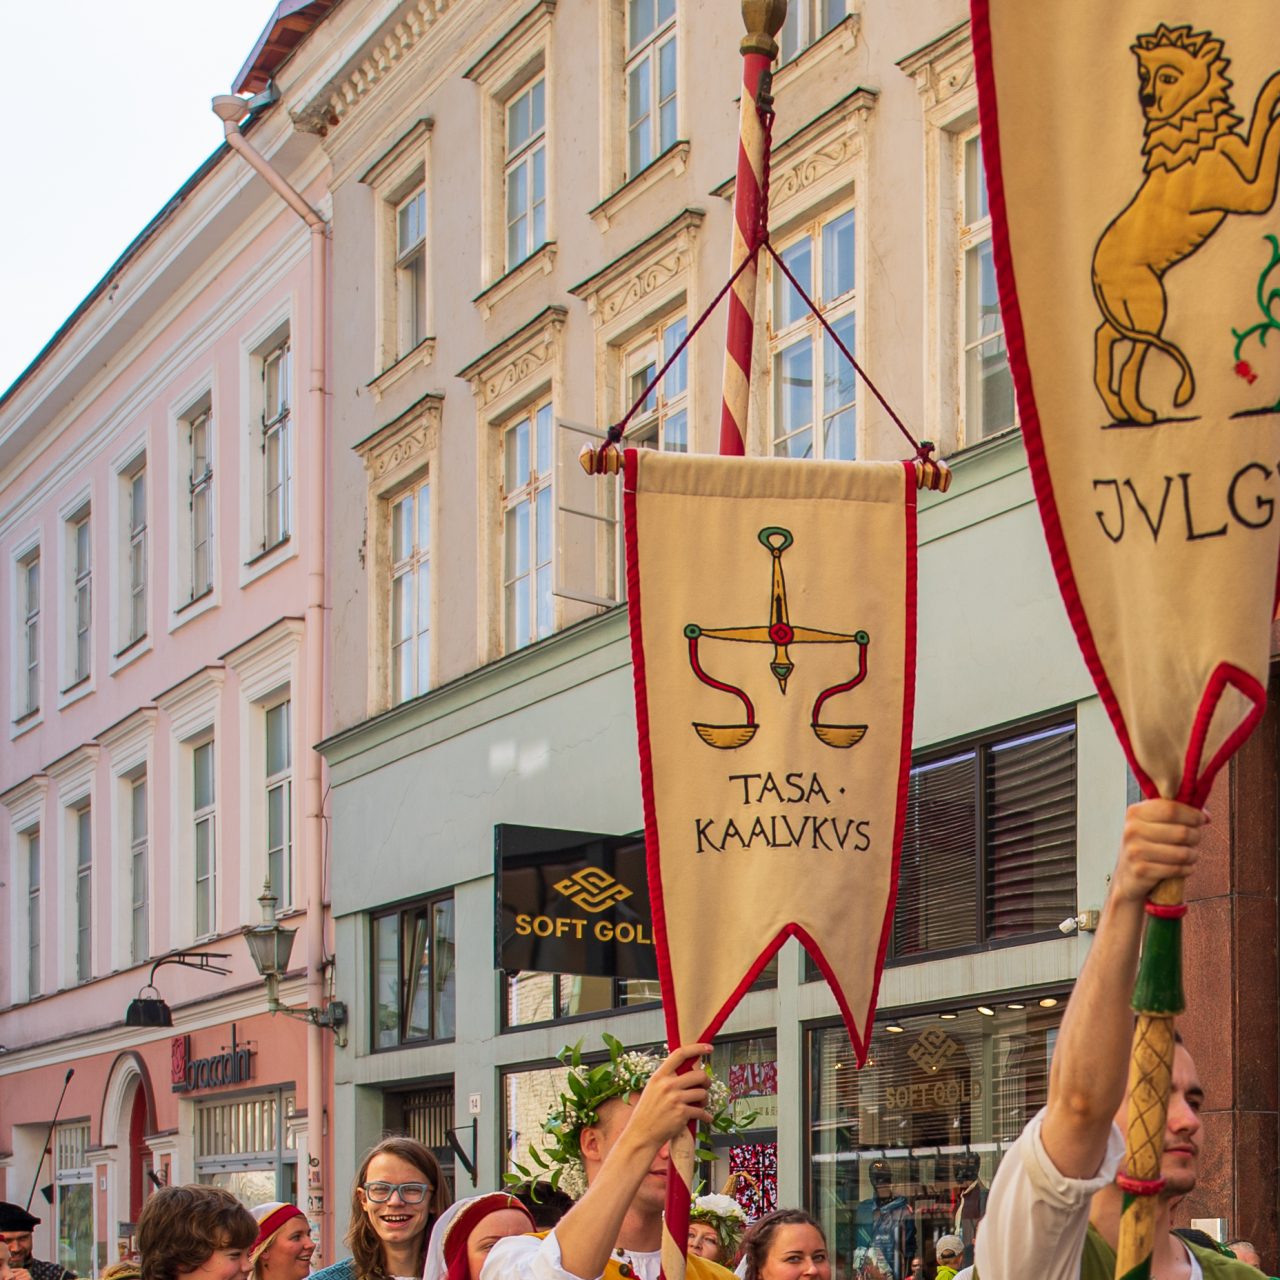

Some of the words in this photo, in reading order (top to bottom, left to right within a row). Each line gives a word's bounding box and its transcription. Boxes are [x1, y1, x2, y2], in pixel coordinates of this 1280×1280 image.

[694, 814, 871, 854] KAALVKVS
[514, 913, 588, 939] SOFT
[593, 919, 656, 945] GOL
[885, 1083, 930, 1110] SOFT
[933, 1078, 983, 1106] GOLD
